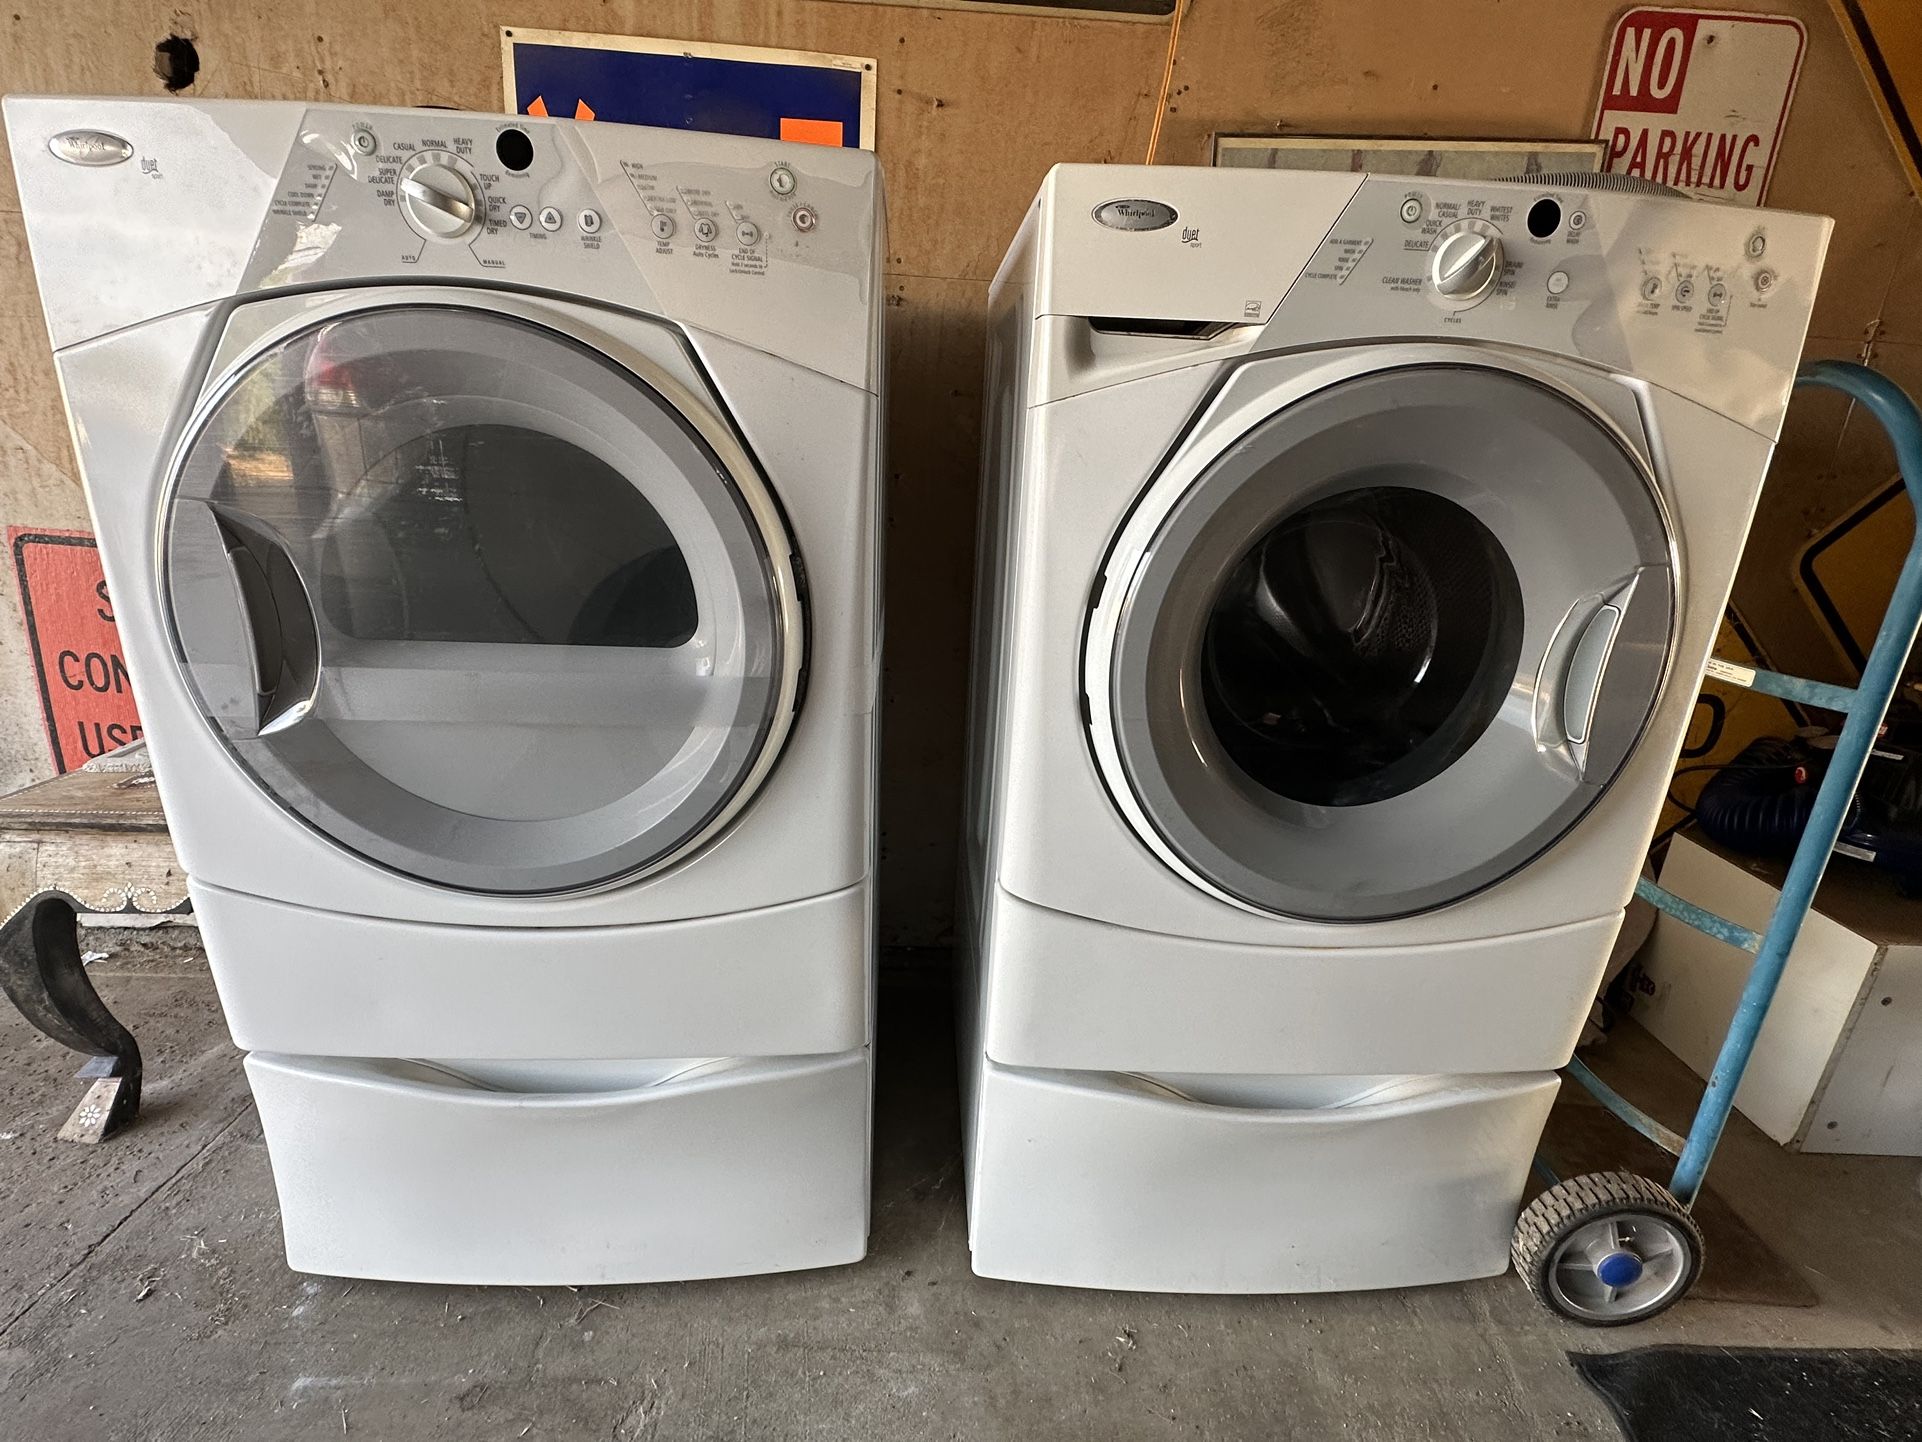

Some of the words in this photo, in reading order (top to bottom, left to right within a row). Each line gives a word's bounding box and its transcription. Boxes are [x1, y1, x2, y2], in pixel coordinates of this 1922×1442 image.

[1612, 27, 1684, 99] NO
[422, 139, 447, 148] NORMAL
[453, 138, 473, 146] HEAVY
[393, 142, 416, 151] CASUAL
[456, 147, 472, 155] DUTY
[375, 155, 403, 164] DELICATE
[1605, 127, 1760, 192] PARKING
[378, 167, 397, 176] SUPER
[367, 176, 395, 184] DELICATE
[480, 173, 499, 182] TOUCH
[376, 190, 395, 198] DAMP
[383, 199, 396, 207] DRY
[488, 196, 507, 204] QUICK
[1467, 200, 1486, 208] HEAVY
[488, 205, 500, 213] DRY
[1436, 202, 1461, 211] NORMAL/
[1490, 206, 1513, 214] WHITEST
[1118, 207, 1155, 219] Whirlpool
[1438, 210, 1458, 219] CASUAL
[1467, 207, 1482, 216] DUTY
[1490, 214, 1510, 222] WHITES
[488, 219, 507, 227] TIMED
[1426, 220, 1443, 228] QUICK
[487, 227, 499, 235] DRY
[1182, 226, 1200, 241] duet
[1421, 227, 1437, 235] WASH
[1404, 240, 1429, 249] DELICATE
[1382, 276, 1399, 285] CLEAN
[1400, 278, 1423, 286] WASHER
